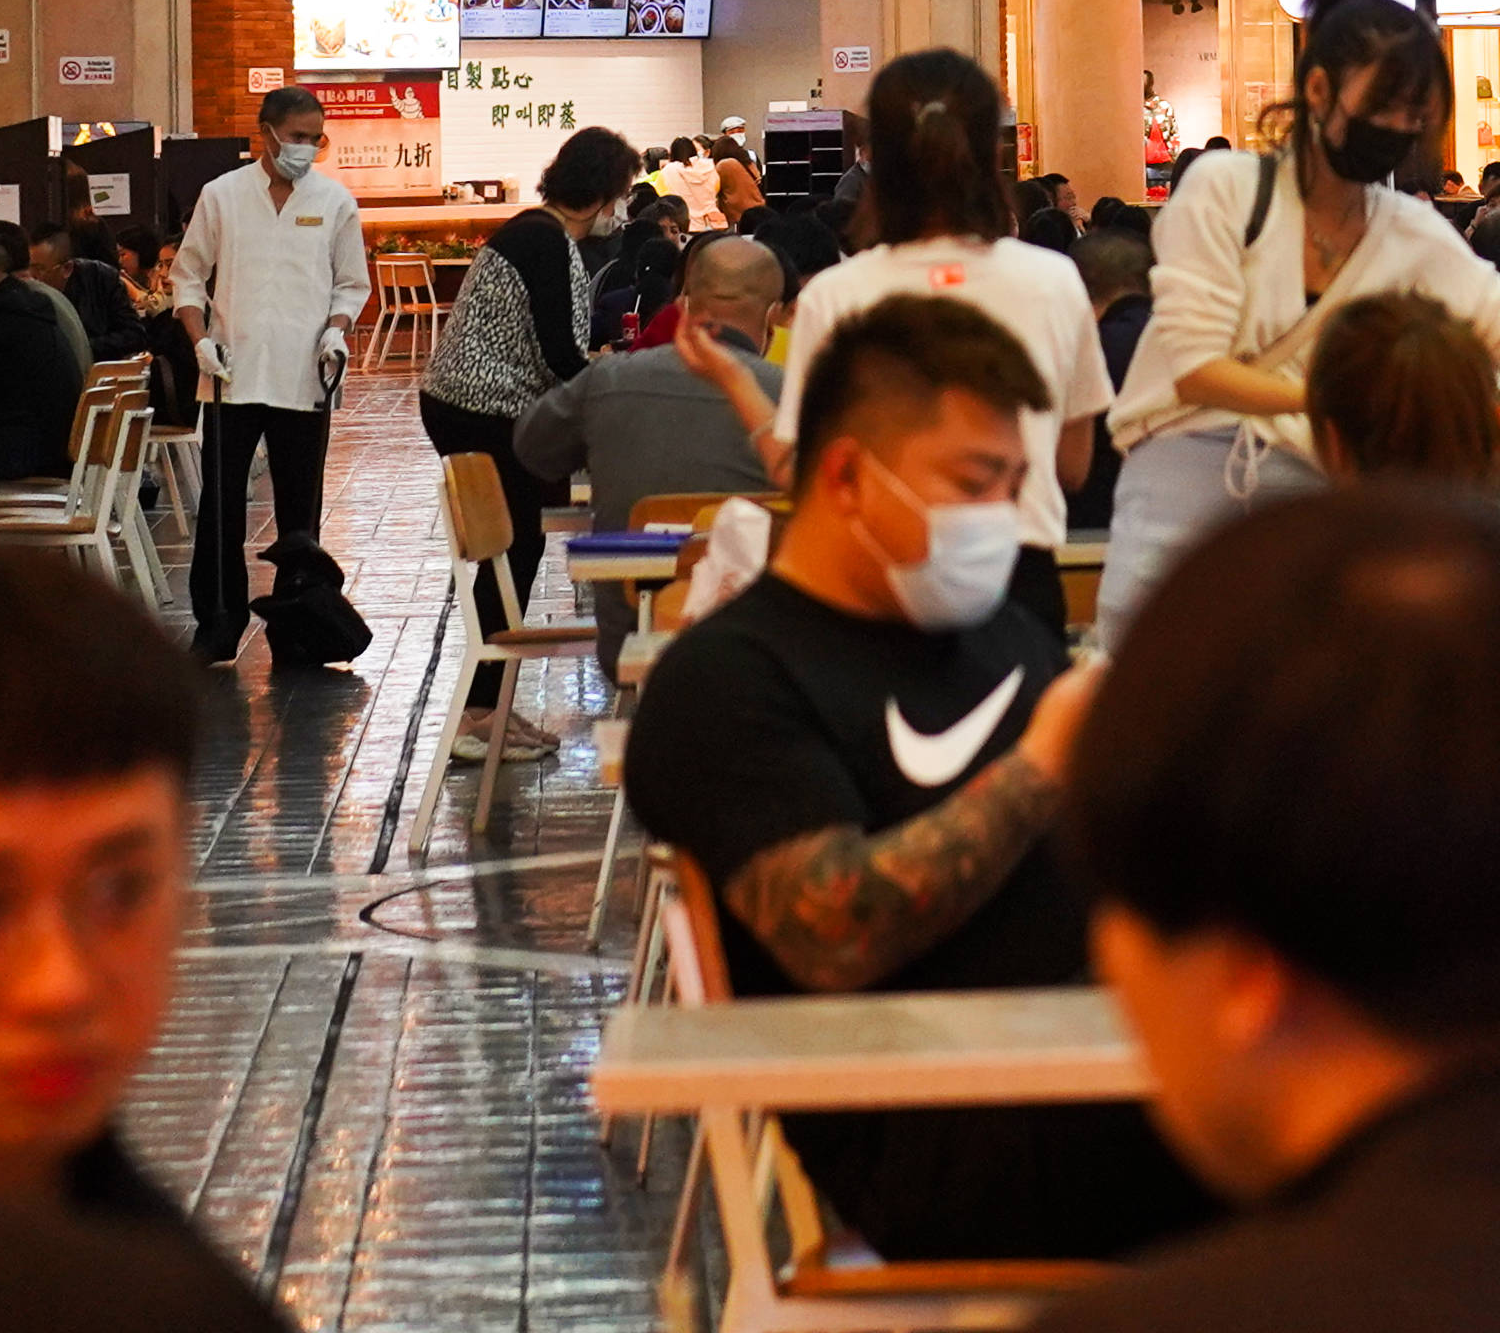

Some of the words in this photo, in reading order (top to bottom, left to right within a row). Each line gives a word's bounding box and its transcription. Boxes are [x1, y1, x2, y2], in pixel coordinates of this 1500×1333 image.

[447, 60, 534, 91] 自製點心
[491, 100, 578, 131] 即叫即蒸
[394, 142, 433, 169] 九折
